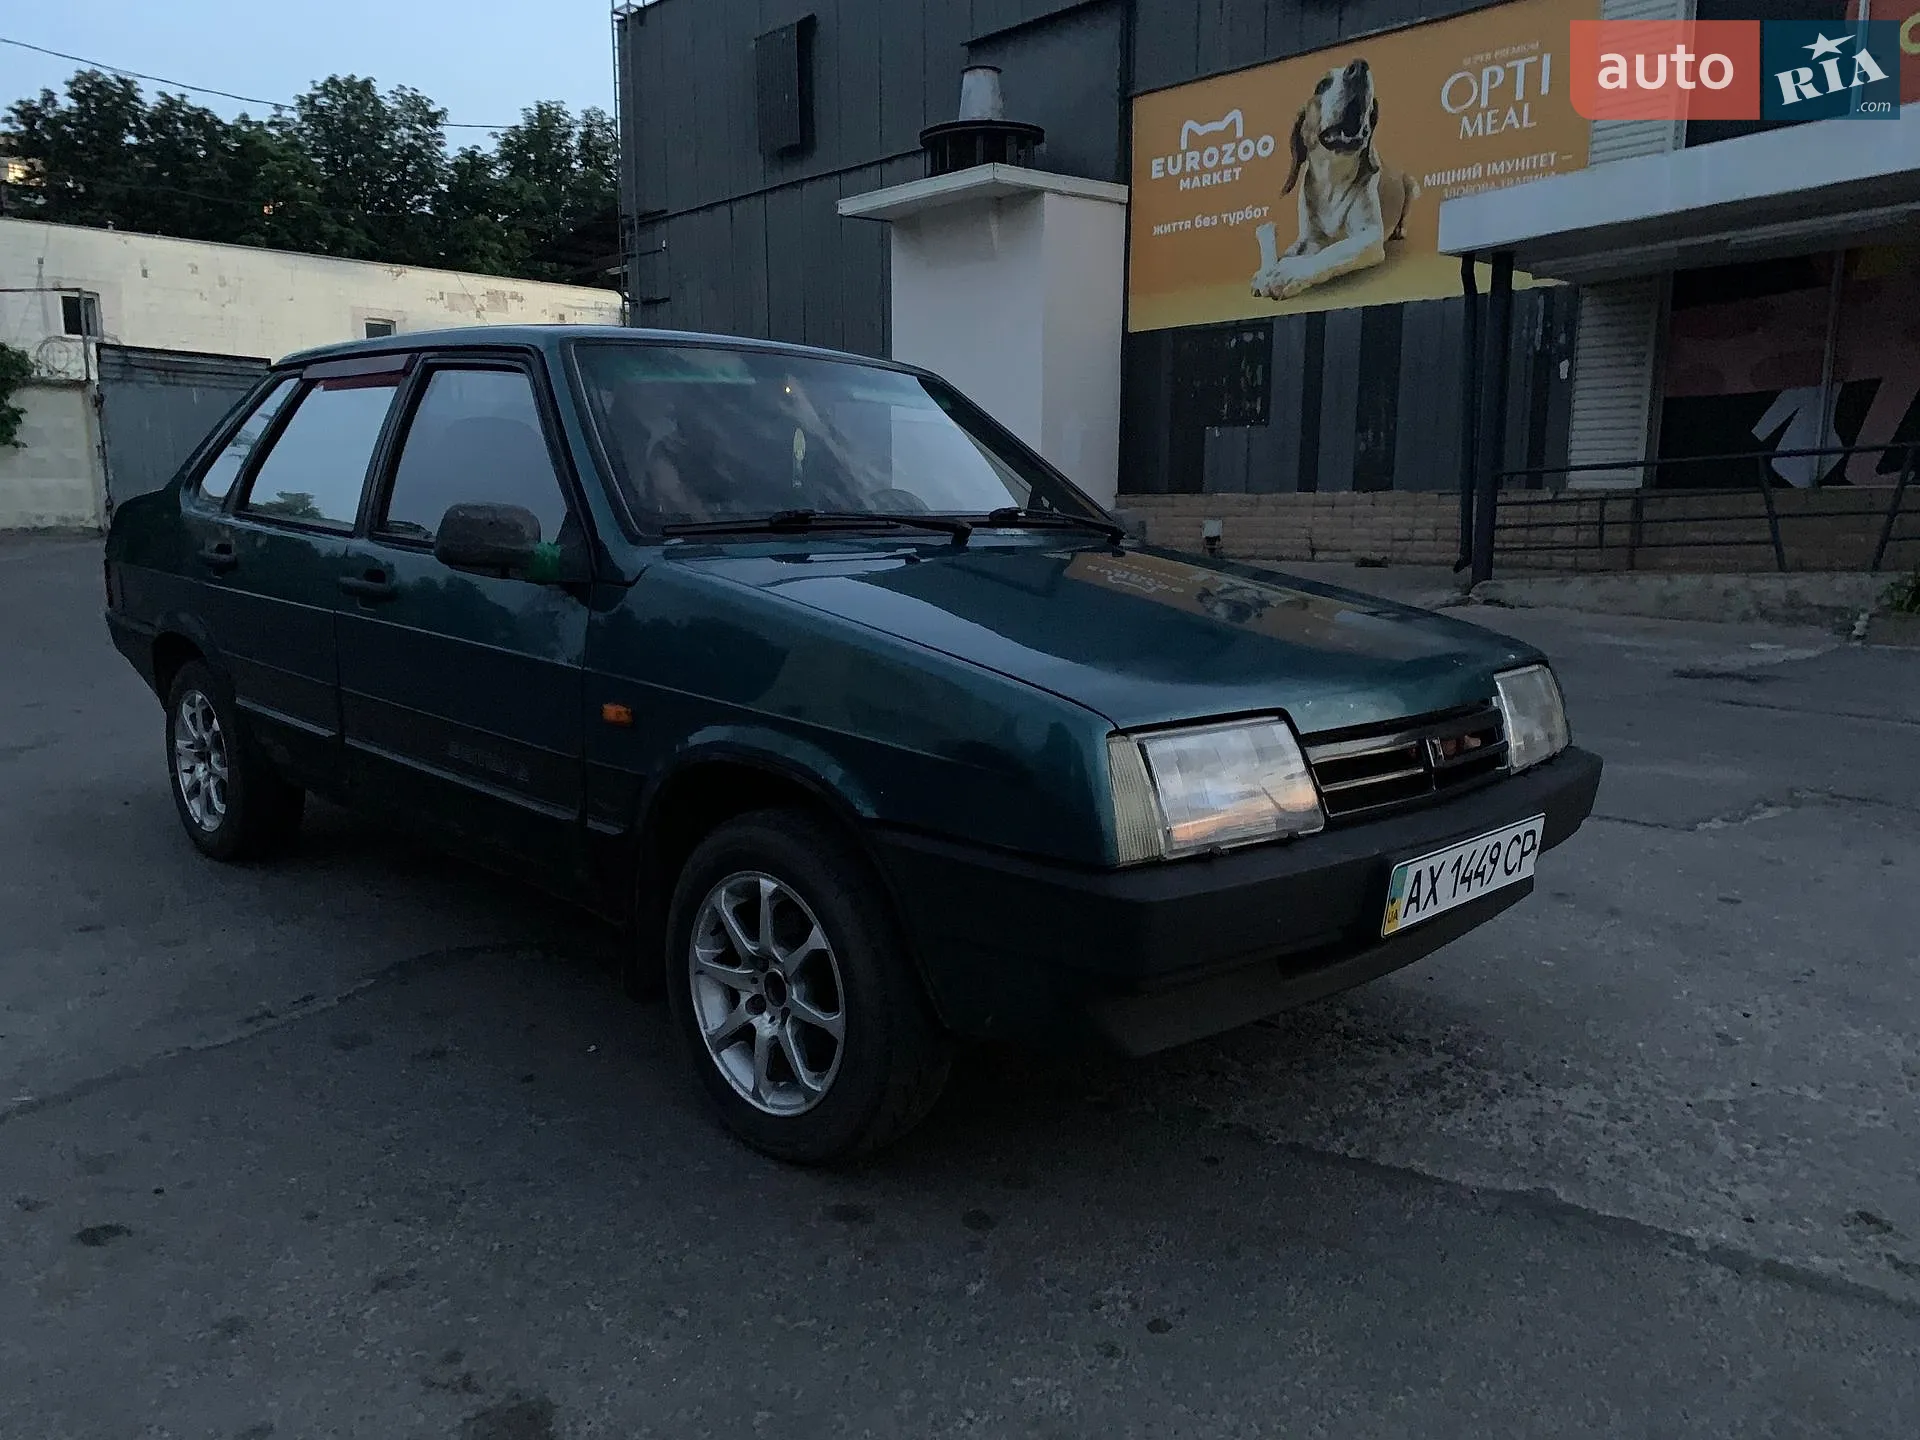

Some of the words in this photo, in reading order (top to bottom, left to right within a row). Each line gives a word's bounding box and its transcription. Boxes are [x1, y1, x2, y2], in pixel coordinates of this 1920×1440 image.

[1441, 53, 1551, 114] OPTI
[1459, 102, 1537, 140] MEAL
[1151, 134, 1276, 180] EUROZOO
[1423, 161, 1483, 188] МІЦНИЙ
[1487, 151, 1557, 177] ІМУНІТЕТ
[1179, 167, 1242, 191] MARKET
[1152, 218, 1192, 236] життя
[1195, 213, 1218, 230] без
[1221, 204, 1270, 227] турбот
[1403, 861, 1446, 919] AX
[1451, 841, 1502, 899] 1449
[1504, 829, 1538, 877] CP
